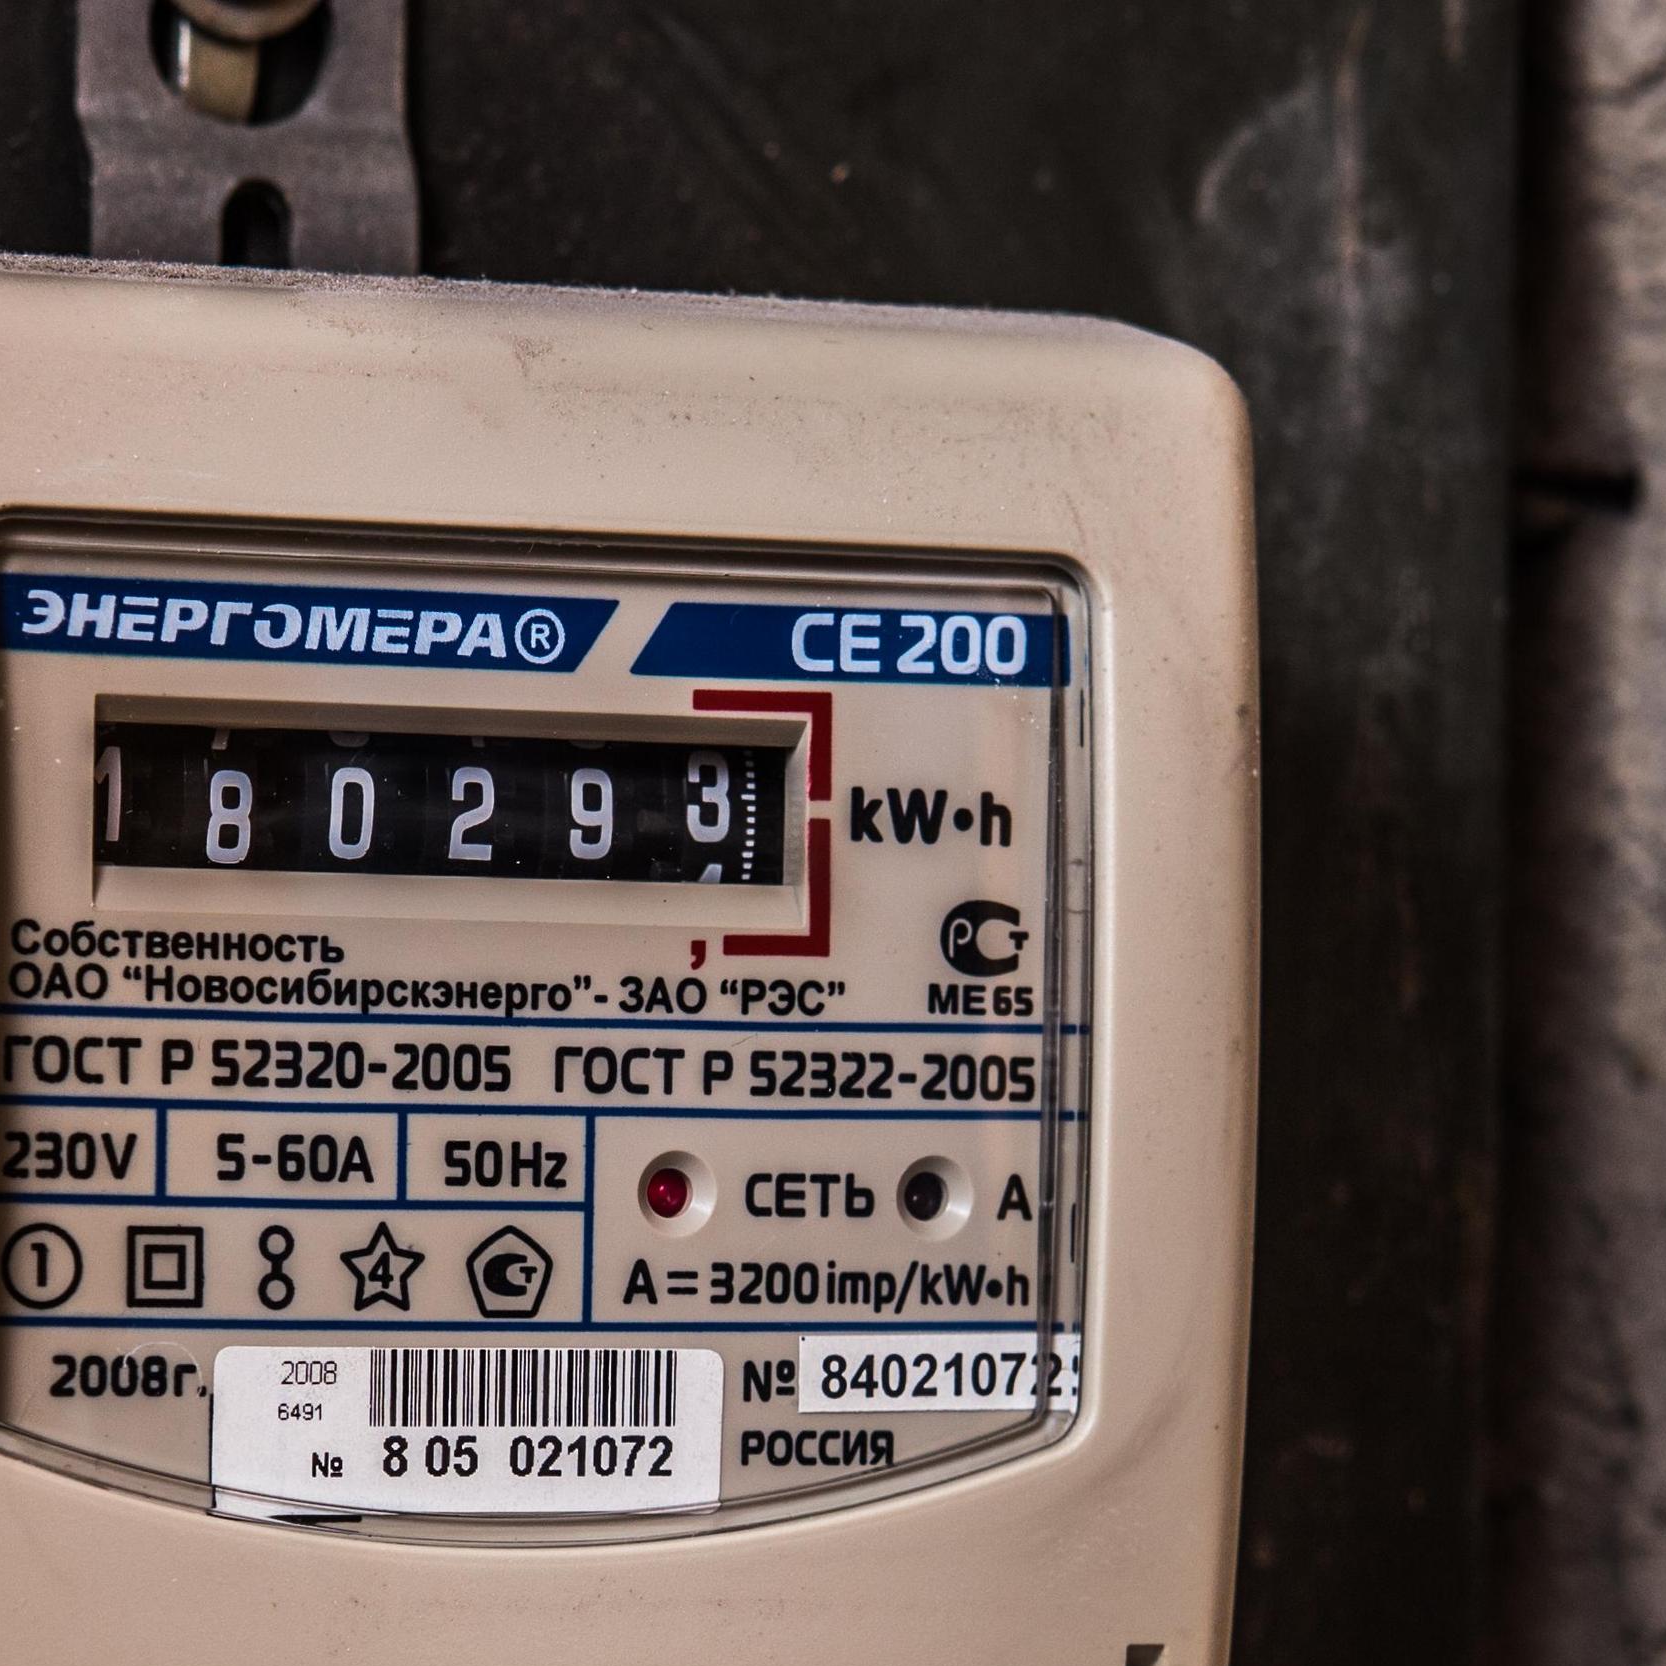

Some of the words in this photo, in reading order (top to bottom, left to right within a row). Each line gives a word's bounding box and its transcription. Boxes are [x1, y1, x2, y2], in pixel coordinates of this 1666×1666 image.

[897, 614, 1027, 675] 200
[11, 919, 345, 963] Собственность
[8, 963, 108, 1000] ОАО
[618, 977, 707, 1014] ЗАО
[3, 1036, 141, 1084] ГОСТ
[161, 1039, 193, 1085] Р
[211, 1040, 511, 1092] 52320-2005
[553, 1046, 685, 1094] ГОСТ
[703, 1050, 733, 1095] Р
[749, 1051, 1035, 1100] 52322-2005
[2, 1132, 136, 1179] 230V
[216, 1133, 374, 1183] 5-60A
[444, 1140, 567, 1188] 50Hz
[745, 1173, 875, 1217] СЕТЬ
[281, 1361, 337, 1386] 2008
[743, 1360, 795, 1402] №
[277, 1403, 323, 1421] 6491
[311, 1451, 343, 1478] №
[509, 1435, 673, 1477] 021072
[741, 1430, 894, 1466] РОССИЯ
